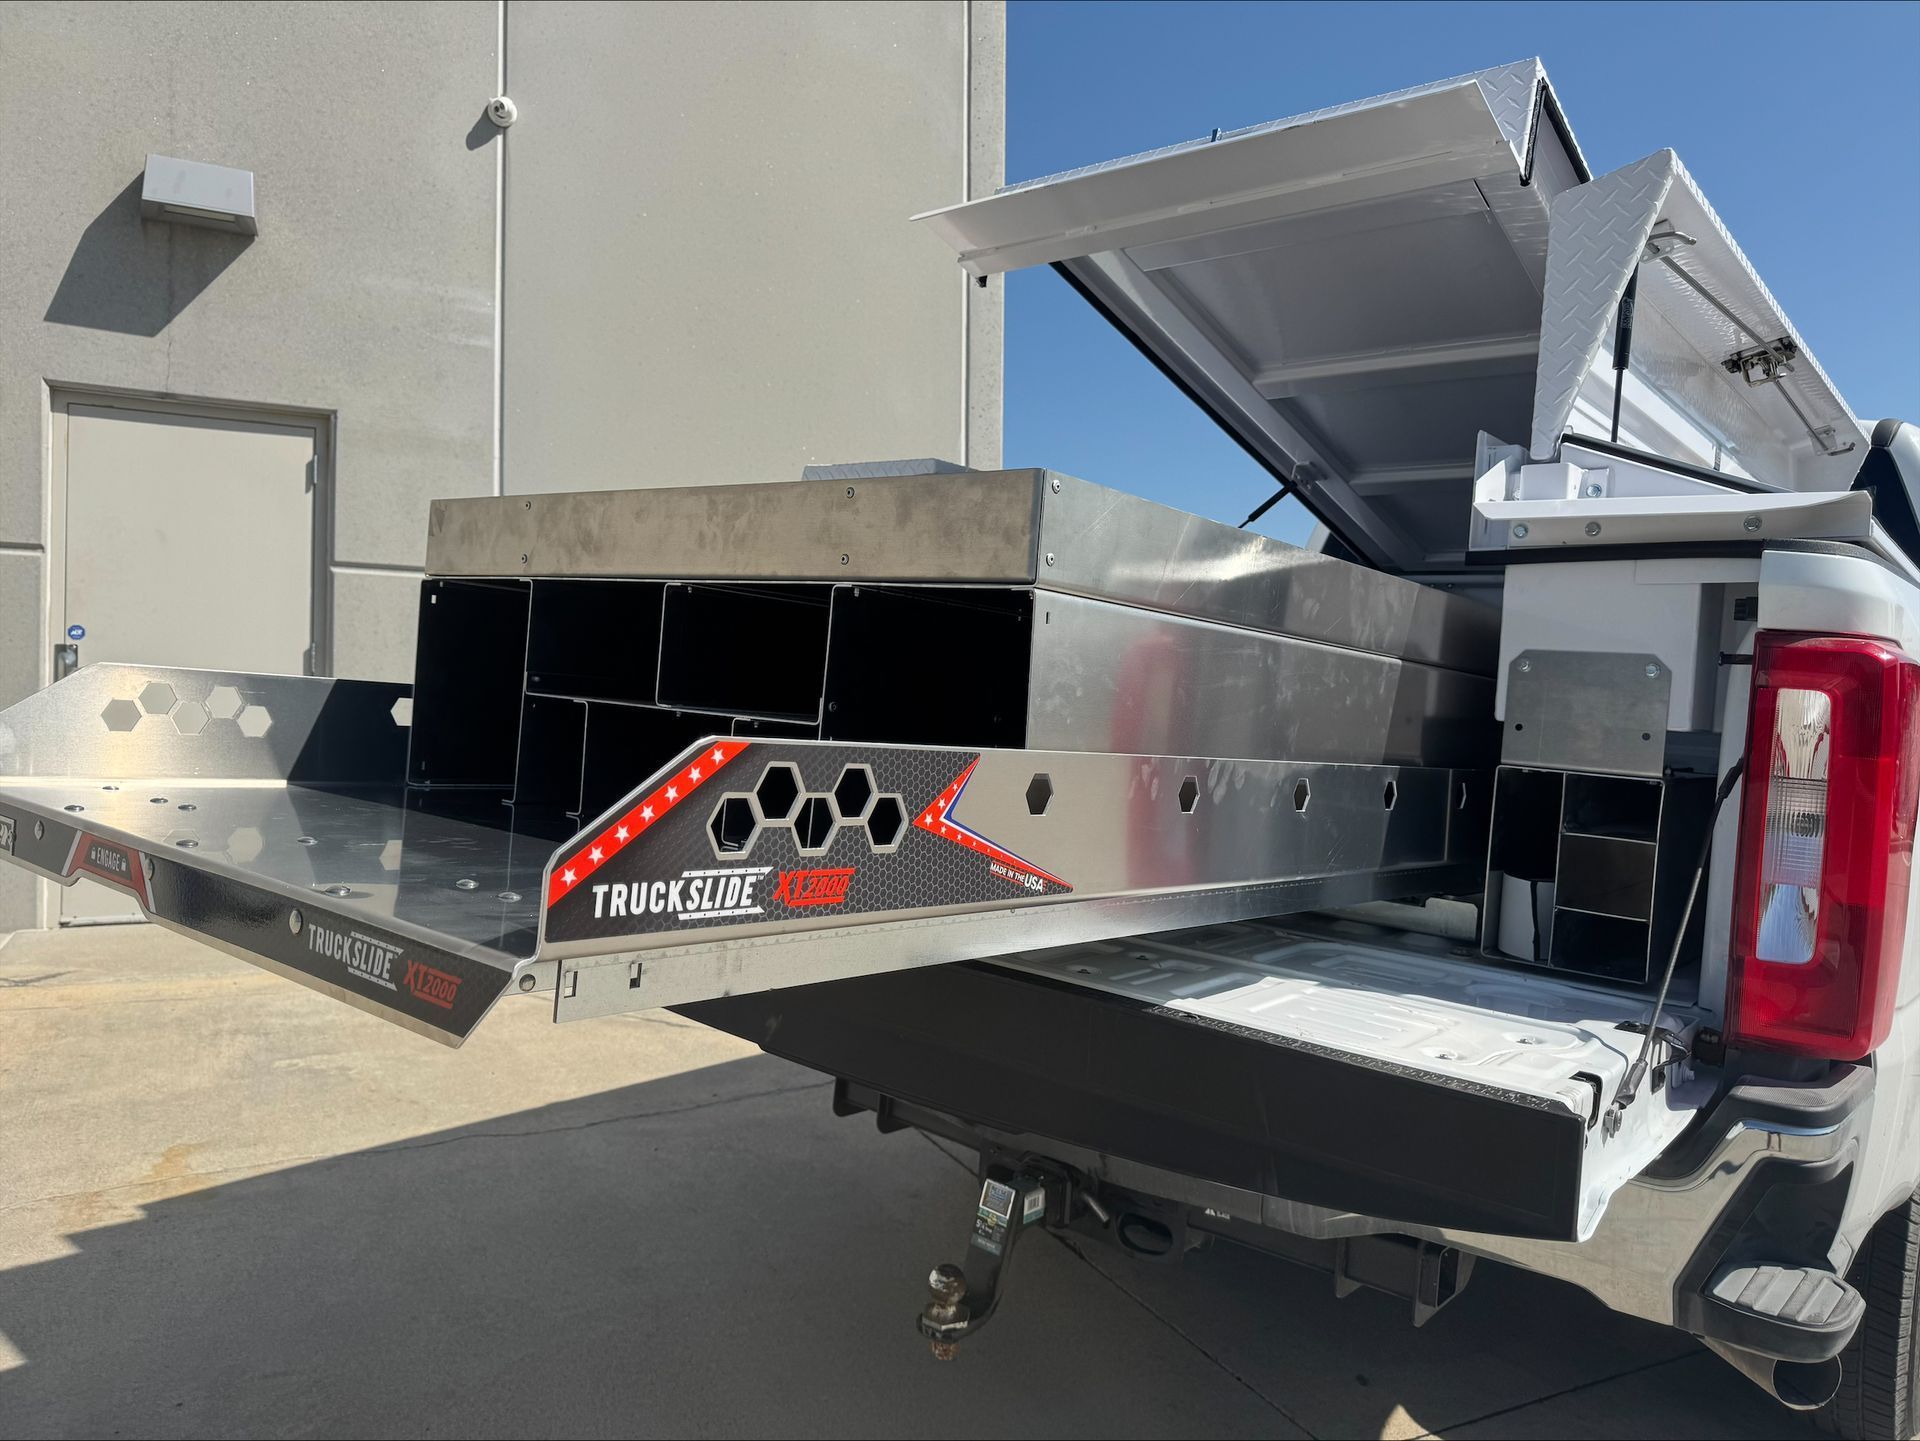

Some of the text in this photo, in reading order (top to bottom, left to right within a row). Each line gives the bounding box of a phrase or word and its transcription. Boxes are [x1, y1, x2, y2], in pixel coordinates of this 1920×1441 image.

[96, 847, 121, 872] ENGAGE
[990, 862, 1008, 876] MADE
[1014, 872, 1025, 882] THE
[1024, 873, 1044, 893] USA
[592, 875, 758, 919] TRUCKSLIDE
[773, 868, 855, 906] XT2000
[308, 923, 462, 1009] TRUCKSLIDE XT2000
